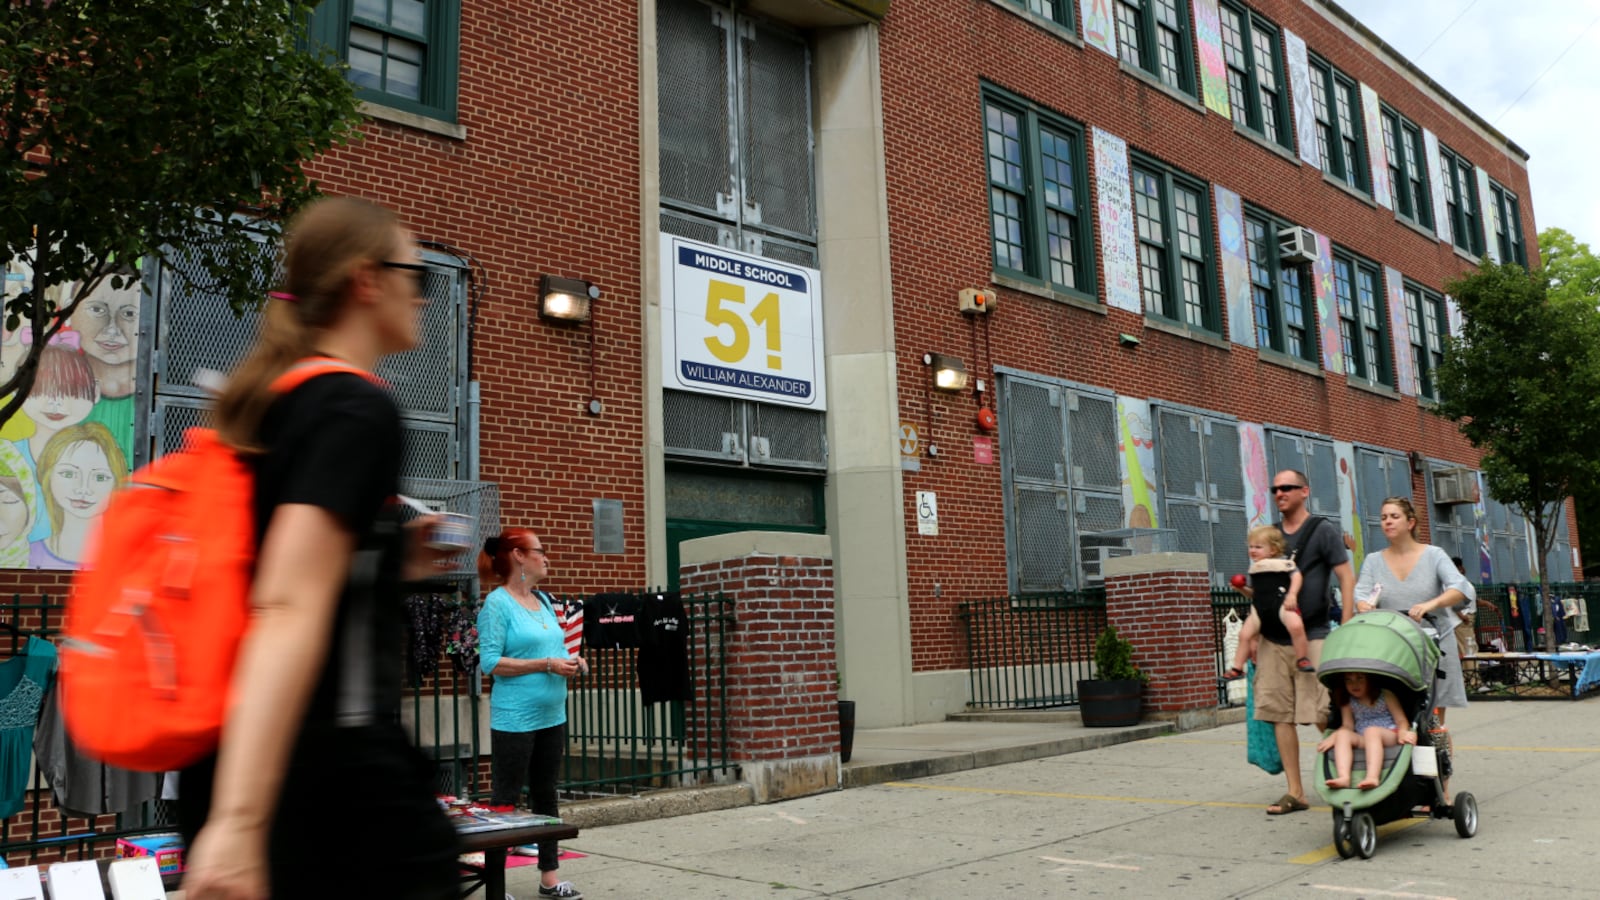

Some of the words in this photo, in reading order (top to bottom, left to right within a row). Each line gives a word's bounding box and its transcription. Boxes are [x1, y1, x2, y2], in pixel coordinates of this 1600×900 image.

[695, 253, 742, 276] MIDDLE
[744, 266, 793, 288] SCHOOL
[686, 364, 736, 384] WILLIAM
[739, 375, 807, 396] ALEXANDER
